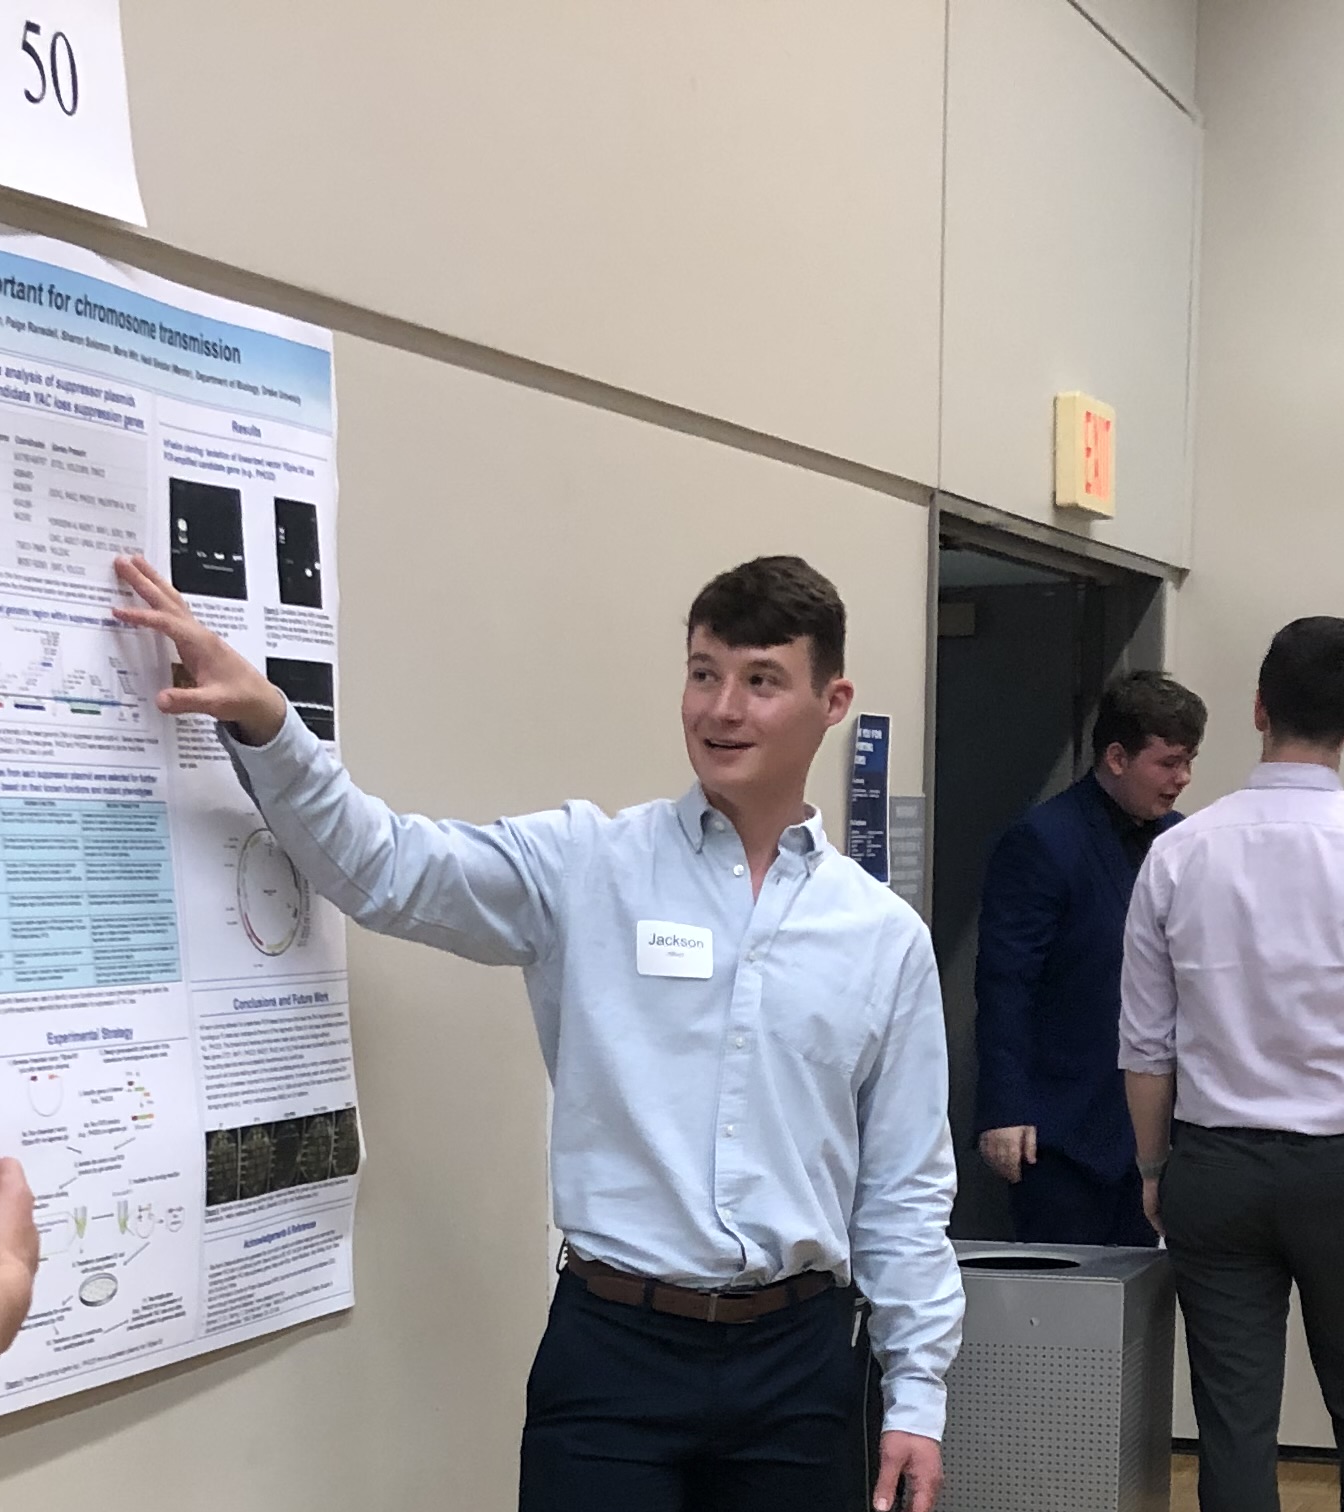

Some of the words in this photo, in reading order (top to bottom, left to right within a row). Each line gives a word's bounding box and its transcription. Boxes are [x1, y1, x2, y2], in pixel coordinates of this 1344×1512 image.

[20, 20, 78, 116] 50
[48, 284, 70, 312] for
[75, 294, 156, 339] chromosome
[159, 321, 241, 364] transmission
[5, 367, 42, 385] analysis
[45, 374, 54, 387] of
[232, 420, 262, 438] Results
[648, 933, 704, 949] Jackson
[233, 997, 276, 1010] Conclusions
[279, 994, 291, 1006] and
[292, 993, 313, 1004] Future
[47, 1028, 99, 1045] Experimental
[101, 1027, 133, 1041] Strategy
